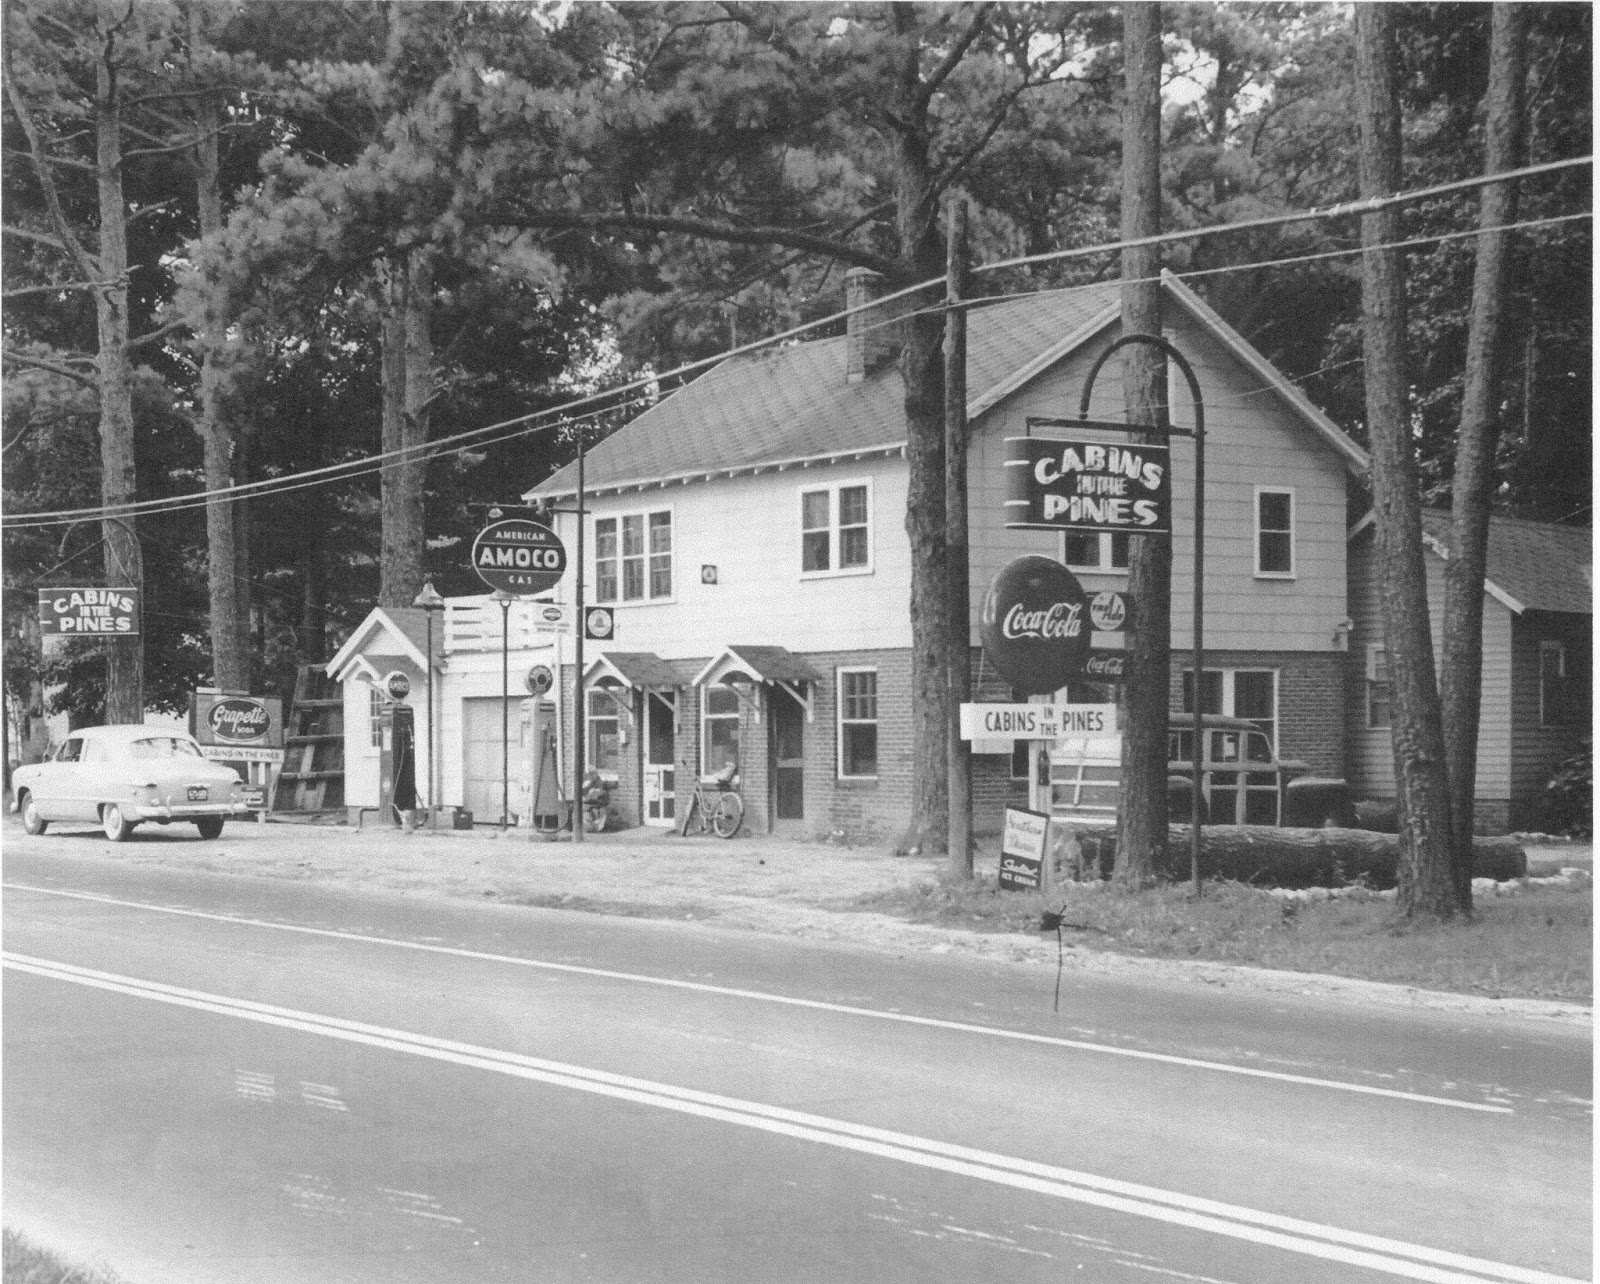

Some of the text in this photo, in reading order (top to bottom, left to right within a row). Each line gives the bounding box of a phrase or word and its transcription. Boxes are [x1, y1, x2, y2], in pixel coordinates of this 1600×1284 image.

[1034, 445, 1164, 491] CABINS
[1077, 475, 1128, 496] IN THE
[1043, 494, 1159, 526] PINES
[496, 531, 546, 541] AMERICAN
[479, 547, 560, 568] AMOCO
[508, 575, 533, 585] GAS
[53, 590, 134, 613] CABINS
[92, 606, 111, 617] THE
[60, 617, 131, 632] PINES
[1003, 602, 1082, 640] Coca-Cola
[211, 705, 267, 732] Grapette
[985, 707, 1104, 736] CABINS IN THE PINES
[204, 748, 233, 757] CABINS
